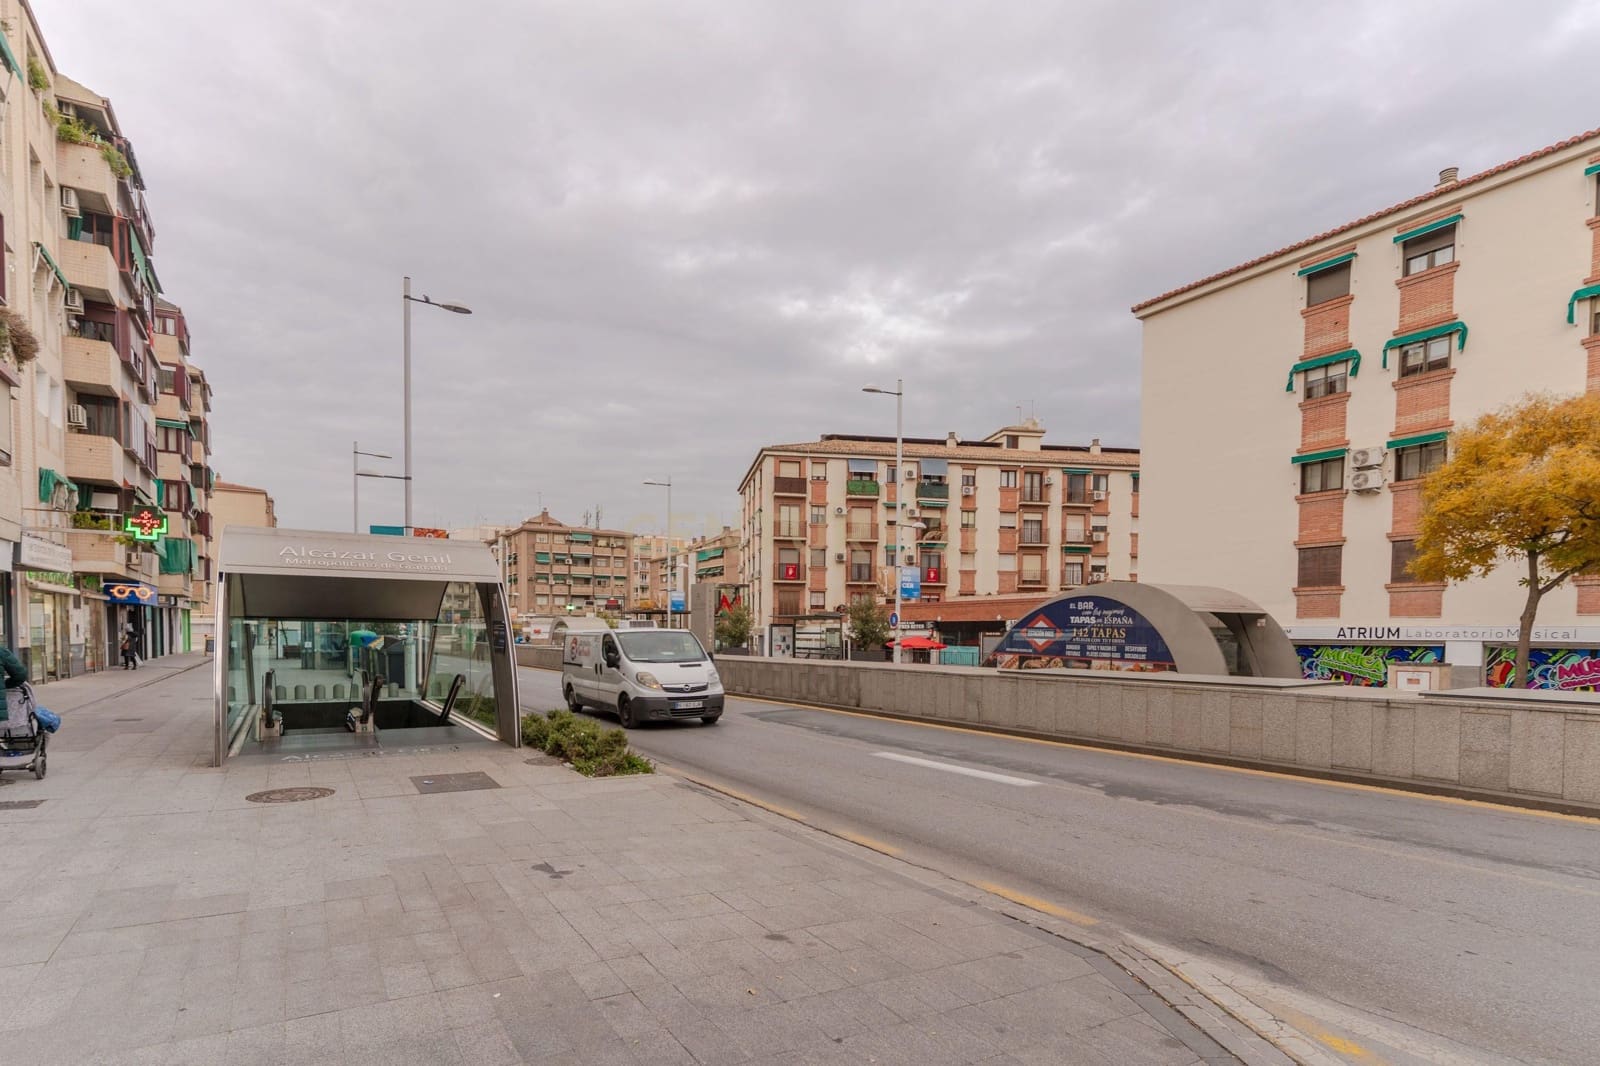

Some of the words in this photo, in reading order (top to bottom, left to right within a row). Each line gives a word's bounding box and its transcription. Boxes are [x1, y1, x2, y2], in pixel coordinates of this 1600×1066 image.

[279, 545, 376, 560] Alcázar
[387, 551, 451, 564] Genil
[1077, 601, 1094, 610] BAR
[1070, 616, 1096, 624] TAPAS
[1103, 616, 1133, 625] ESPAÑA
[1073, 627, 1089, 638] 142
[1091, 627, 1126, 639] TAPAS
[1336, 627, 1400, 639] ATRIUM
